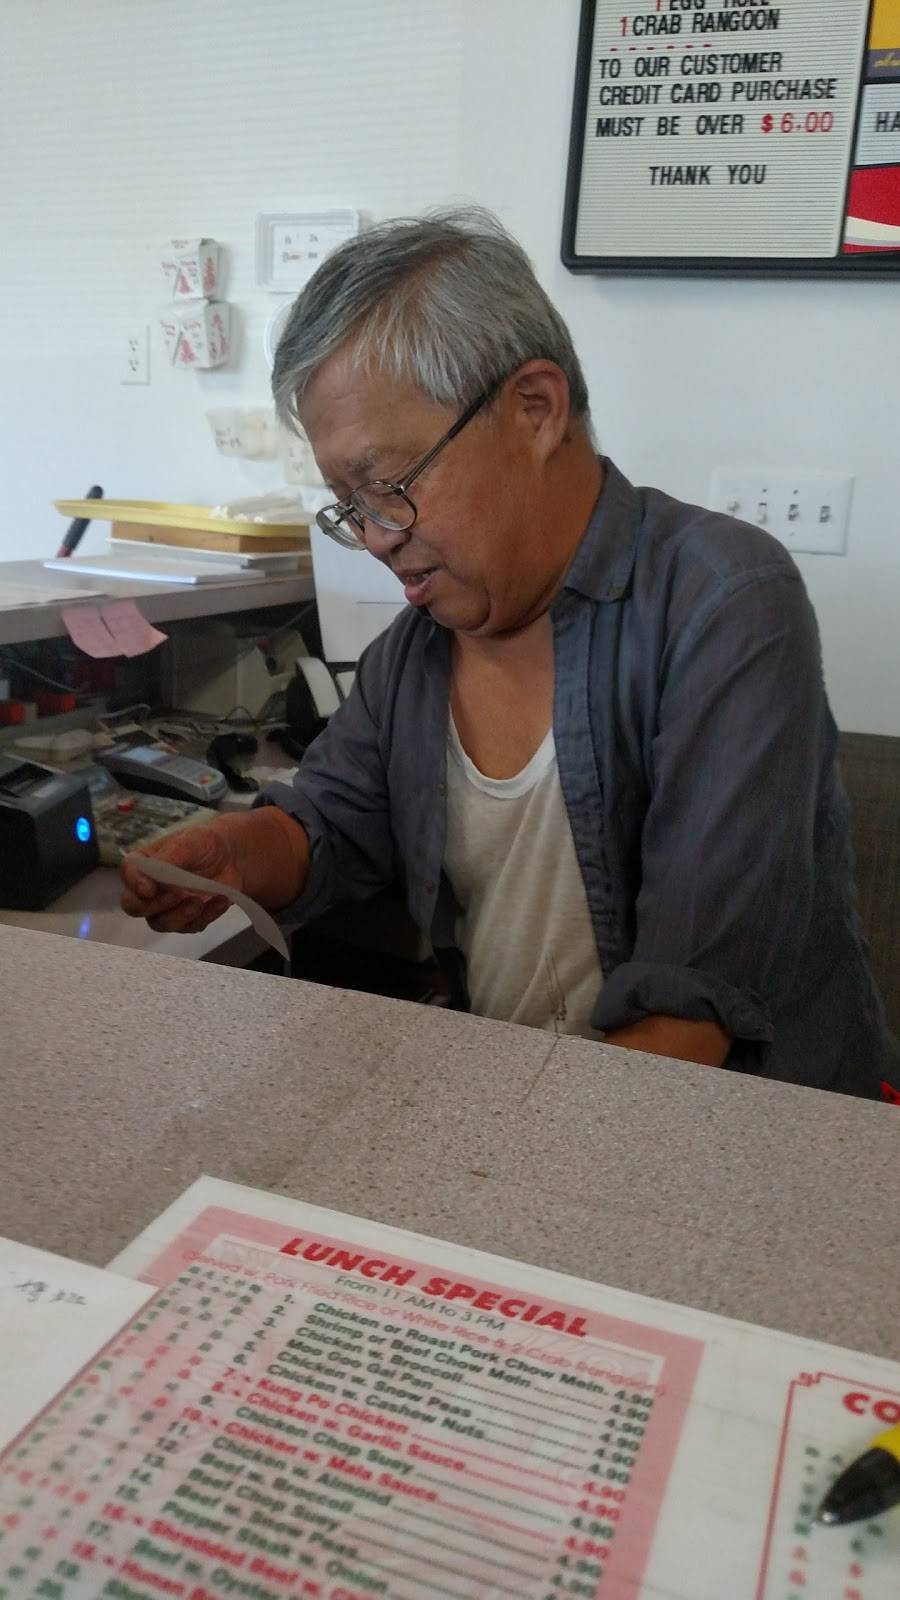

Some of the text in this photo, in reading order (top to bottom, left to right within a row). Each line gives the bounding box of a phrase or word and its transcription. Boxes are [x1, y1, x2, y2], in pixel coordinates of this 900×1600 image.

[620, 9, 780, 37] 1 CRAB RANGOON
[598, 52, 783, 78] TO OUR CUSTOMER
[599, 78, 838, 105] CREDIT CARD PURCHASE
[595, 117, 645, 137] MUST
[657, 116, 681, 136] BE
[696, 114, 744, 135] OVER
[649, 164, 767, 186] THANK YOU
[280, 1238, 416, 1286] LUNCH
[421, 1277, 588, 1337] SPECIAL
[335, 1275, 506, 1331] From 11 AM to 3 PM
[262, 1316, 277, 1329] 3.
[296, 1326, 364, 1354] Chicken
[390, 1353, 465, 1383] Broccoli
[272, 1305, 286, 1317] 2.
[304, 1314, 364, 1340] Shrimp
[367, 1334, 387, 1347] or
[390, 1338, 432, 1358] Beef
[433, 1351, 484, 1374] Chow
[487, 1366, 532, 1388] Mein
[284, 1294, 296, 1305] 1.
[314, 1302, 380, 1329] Chicken
[384, 1322, 402, 1335] or
[405, 1328, 456, 1349] Roast
[459, 1343, 500, 1363] Pork
[504, 1357, 556, 1380] Chow
[286, 1338, 323, 1357] Moo
[327, 1351, 363, 1370] Goo
[366, 1362, 398, 1380] Gai
[400, 1372, 434, 1391] Pan
[402, 1311, 449, 1332] White
[526, 1348, 573, 1368] Crab
[256, 1377, 304, 1403] Kung
[307, 1392, 331, 1410] Po
[334, 1402, 410, 1435] Chicken
[266, 1363, 337, 1394] Chicken
[365, 1394, 438, 1424] Cashew
[441, 1416, 486, 1440] Nuts
[276, 1350, 347, 1380] Chicken
[373, 1380, 423, 1403] Snow
[426, 1396, 473, 1419] Peas
[224, 1421, 299, 1455] Chicken
[378, 1471, 439, 1502] Sauce
[235, 1405, 309, 1439] Chicken
[312, 1430, 362, 1457] Chop
[366, 1448, 415, 1477] Suey
[246, 1391, 320, 1425] Chicken
[346, 1423, 402, 1452] Garlic
[406, 1442, 466, 1472] Sauce
